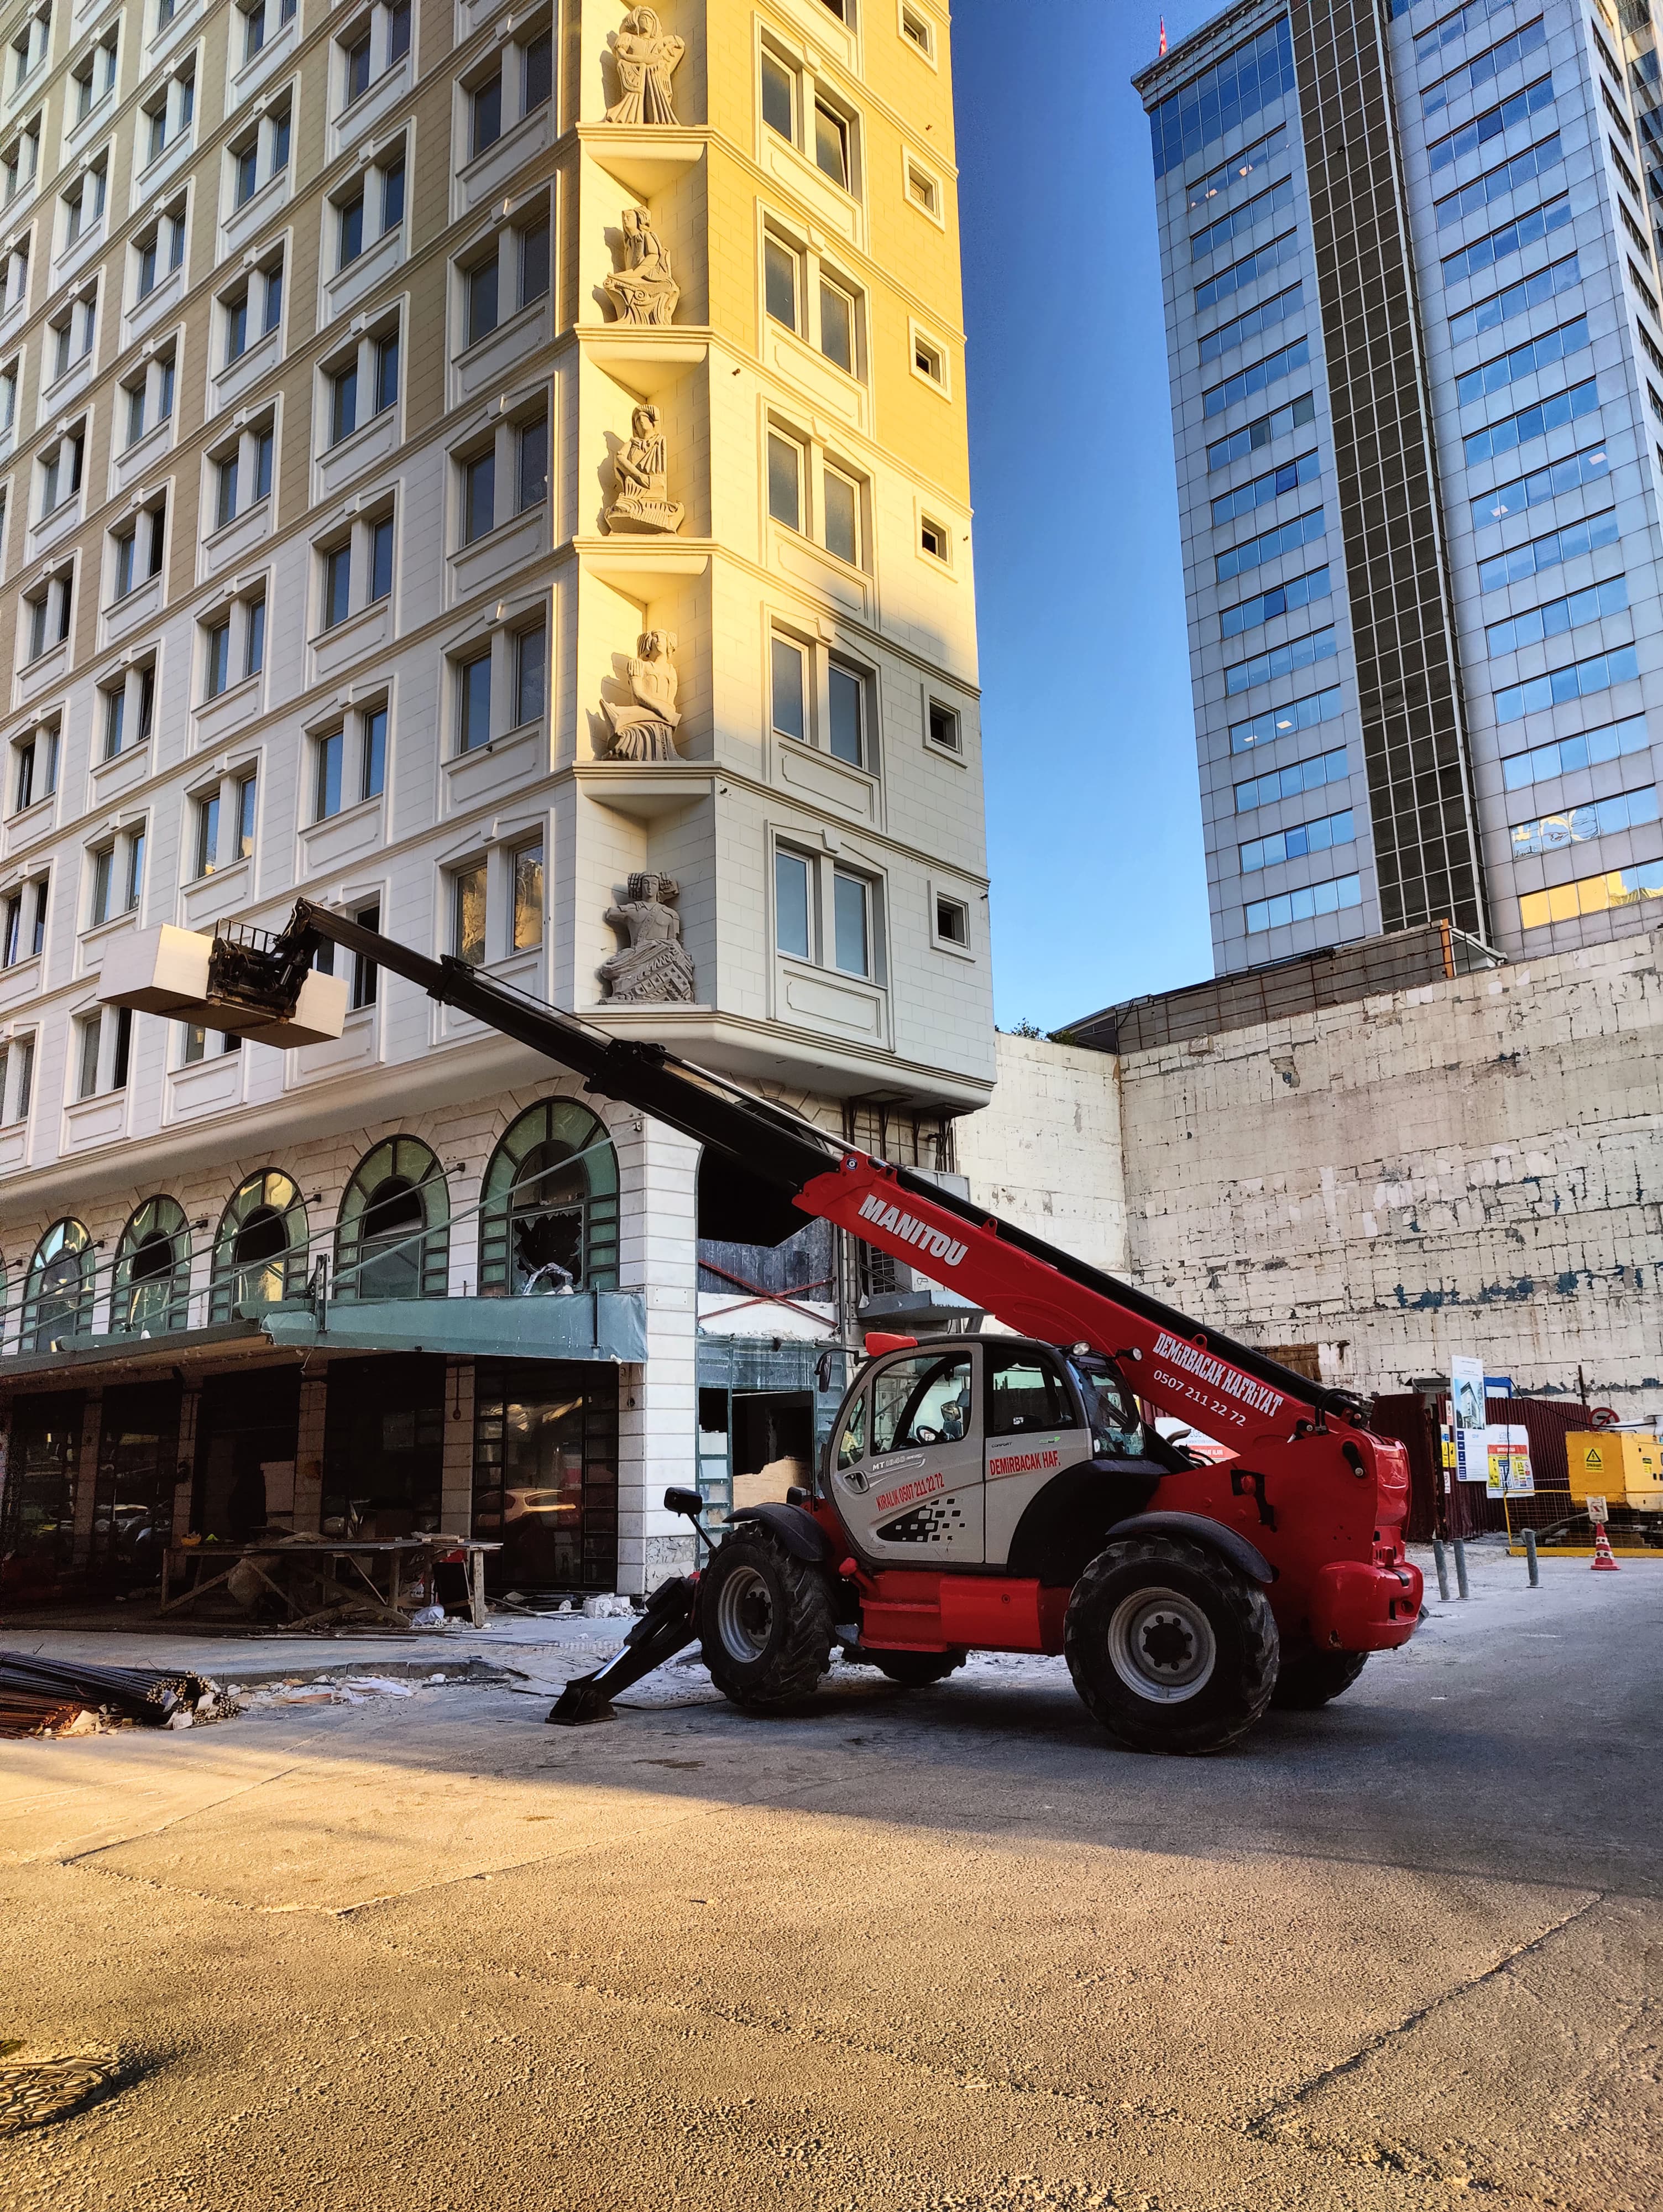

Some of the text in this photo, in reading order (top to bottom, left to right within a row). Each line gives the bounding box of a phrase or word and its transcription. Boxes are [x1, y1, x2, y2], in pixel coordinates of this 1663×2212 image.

[857, 1192, 969, 1266] MANITOU
[1153, 1370, 1246, 1427] 0507 211 22 72
[872, 1461, 885, 1471] MT
[898, 1484, 914, 1503] 0507
[914, 1479, 927, 1497] 211
[926, 1475, 935, 1493] 22
[934, 1472, 945, 1489] 72
